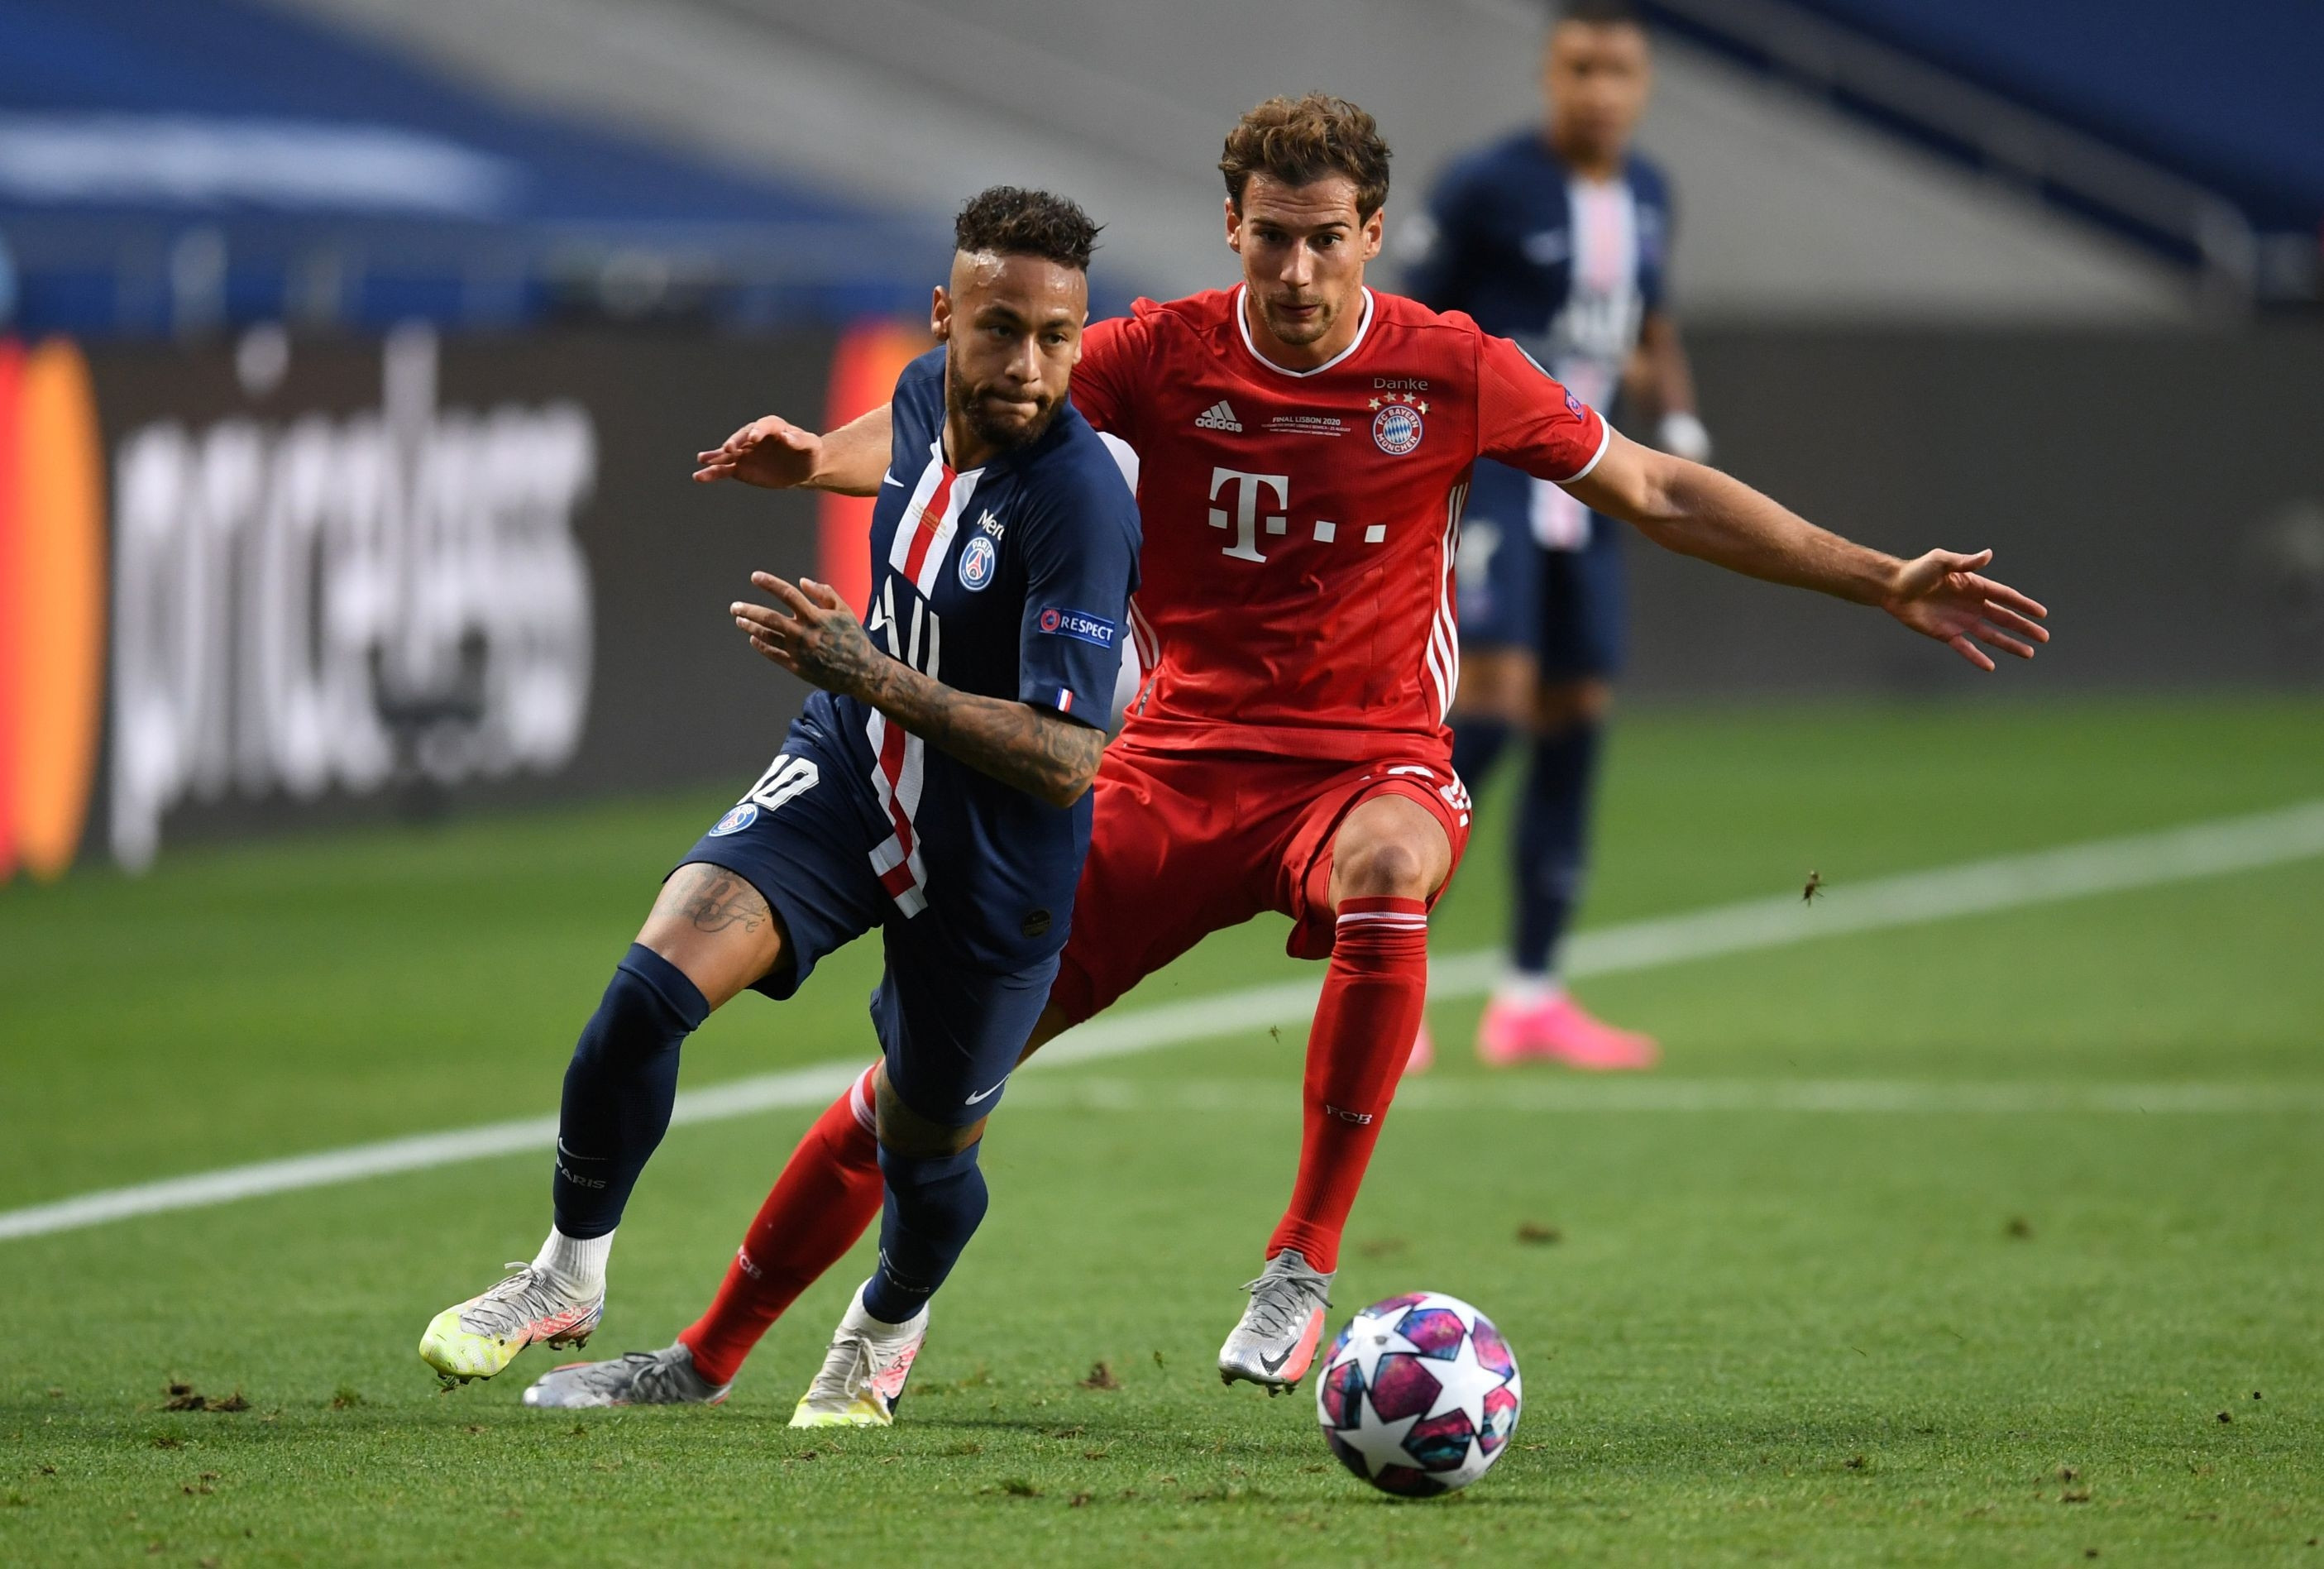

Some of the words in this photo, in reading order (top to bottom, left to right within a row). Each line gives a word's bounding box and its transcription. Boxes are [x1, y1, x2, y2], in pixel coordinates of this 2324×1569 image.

[1374, 378, 1428, 390] Danke
[1195, 417, 1243, 433] adidas
[1294, 416, 1322, 424] LISBON
[1322, 418, 1341, 426] 2020
[1377, 414, 1388, 425] FC
[1388, 408, 1419, 428] BAYERN
[972, 540, 992, 559] PARIS
[1060, 615, 1114, 641] RESPECT
[735, 753, 820, 811] 10
[1326, 1104, 1373, 1125] FCB
